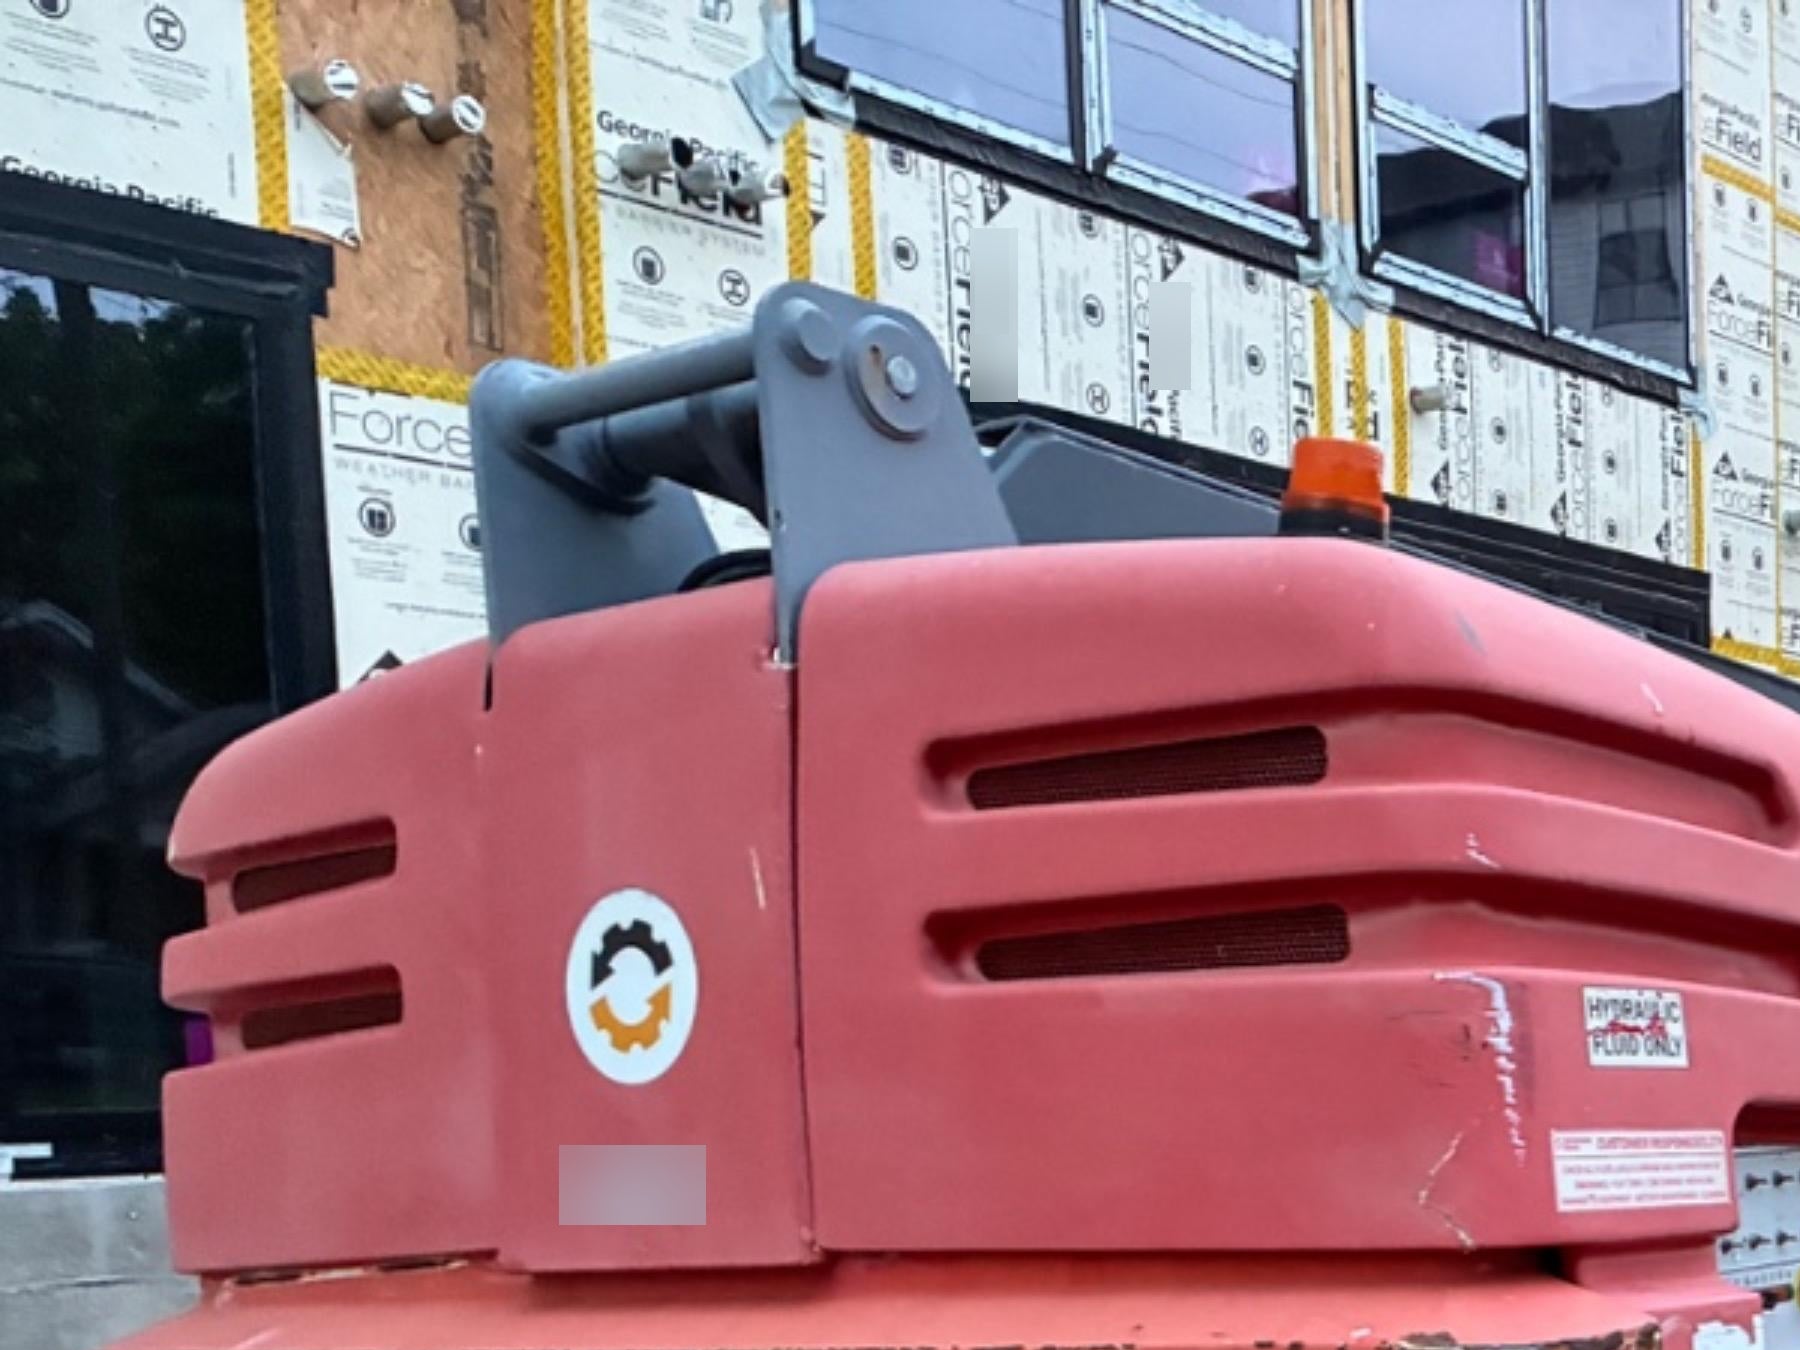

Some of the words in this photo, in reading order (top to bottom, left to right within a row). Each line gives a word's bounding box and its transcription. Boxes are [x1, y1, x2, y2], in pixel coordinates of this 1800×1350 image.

[330, 387, 473, 458] Force
[1587, 997, 1681, 1024] HYDRAULIC
[1592, 1028, 1639, 1057] FLUID
[1644, 1034, 1682, 1058] ONLY
